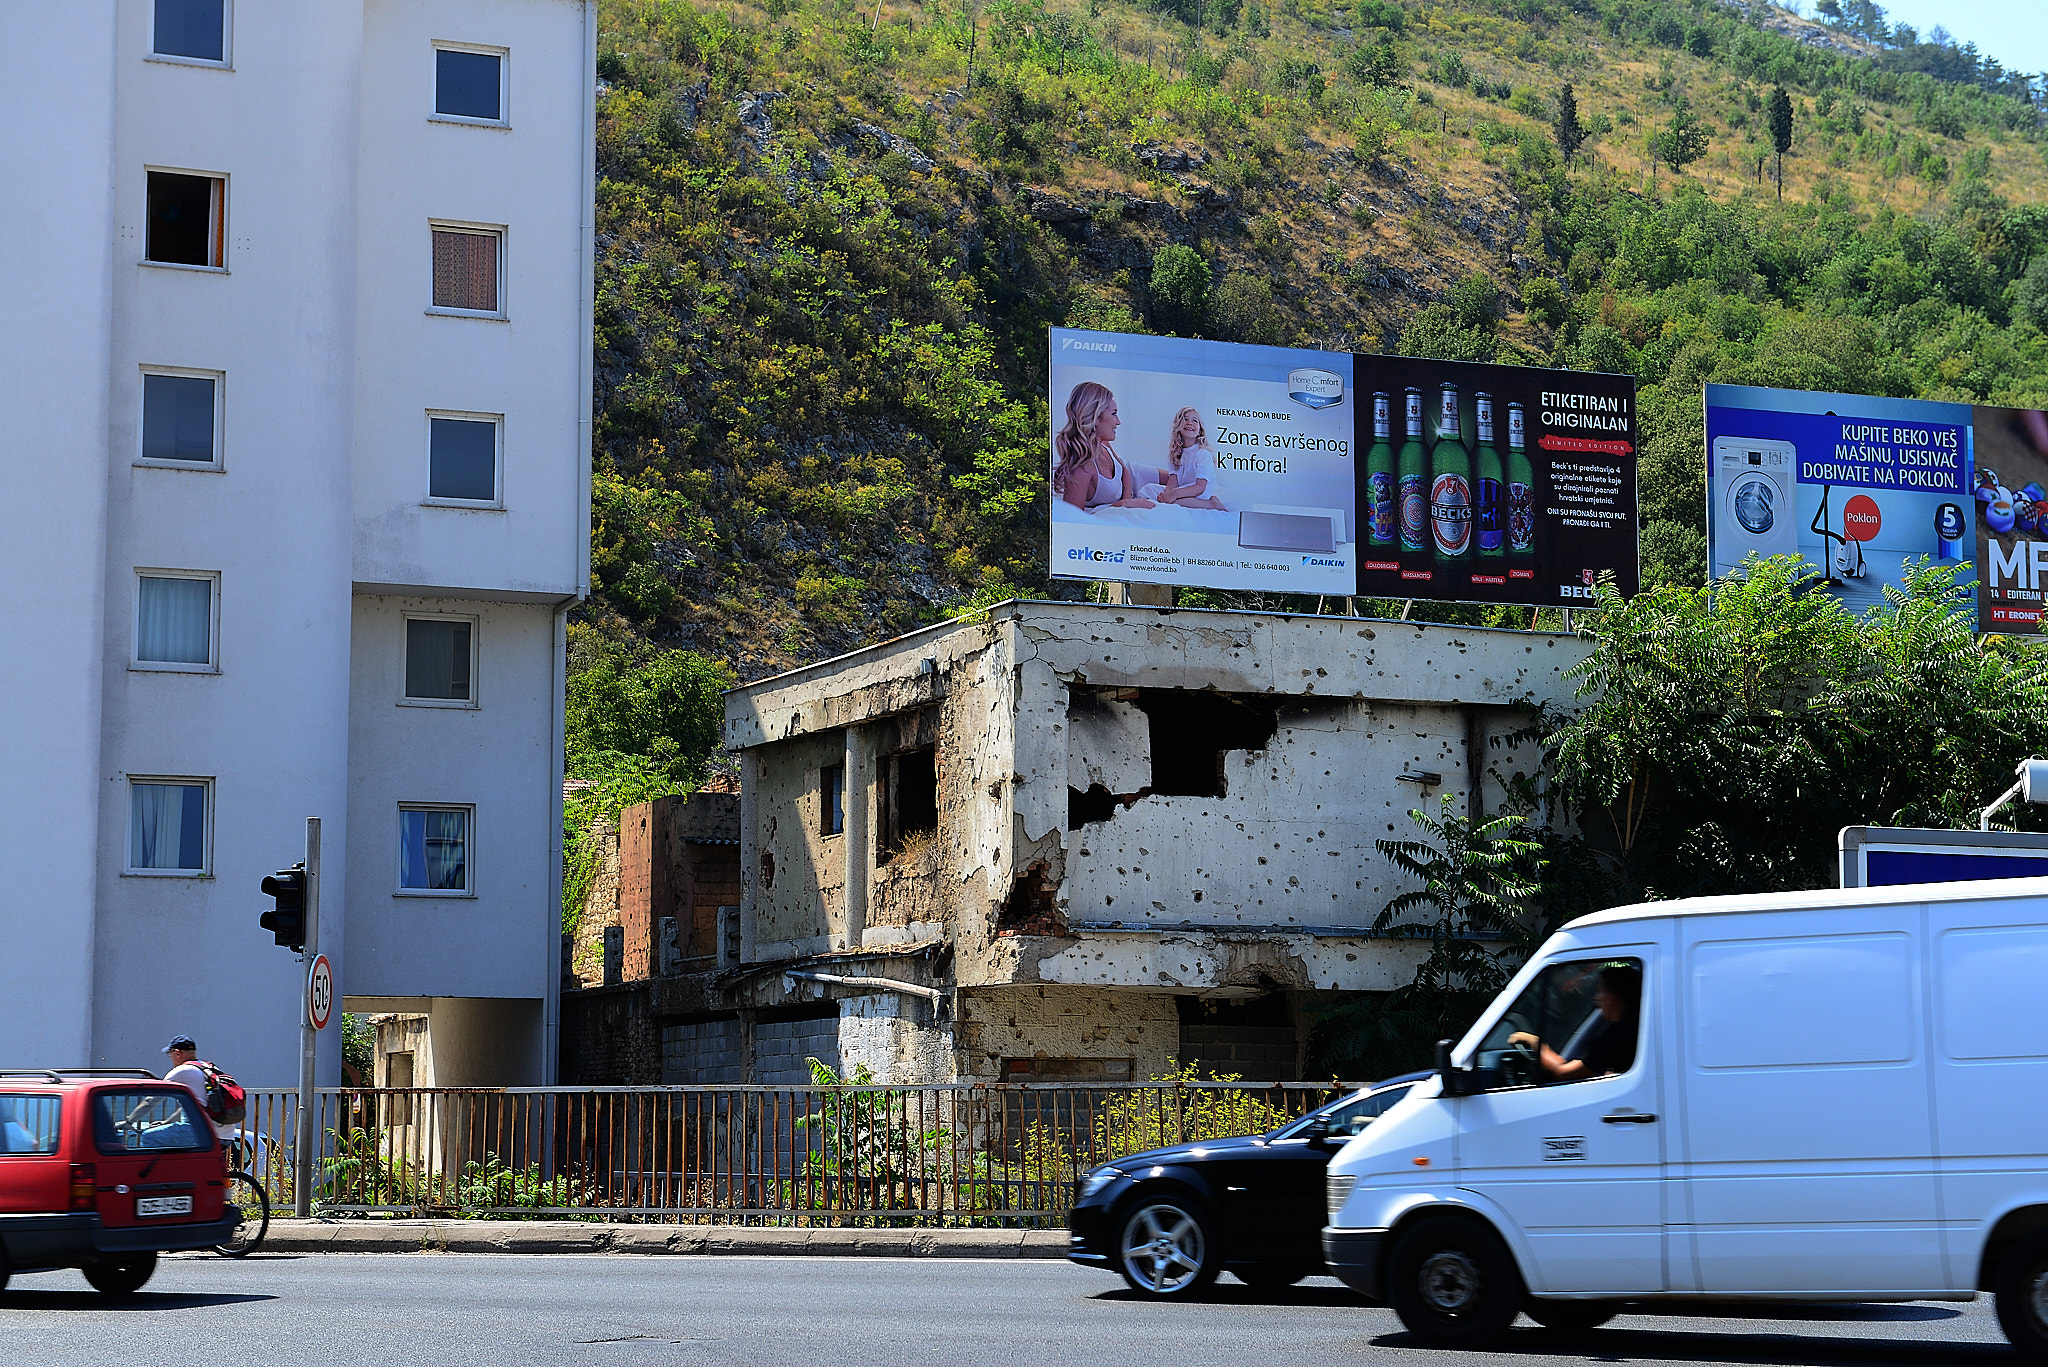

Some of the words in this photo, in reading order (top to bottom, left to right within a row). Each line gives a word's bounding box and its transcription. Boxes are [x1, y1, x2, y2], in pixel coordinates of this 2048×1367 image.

[1073, 341, 1117, 353] DAIKIN
[1292, 376, 1311, 384] Home
[1305, 384, 1326, 393] Expert
[1541, 392, 1618, 413] ETIKETIRAN
[1623, 398, 1627, 413] I
[1216, 408, 1236, 417] NEKA
[1237, 409, 1251, 418] VAŠ
[1252, 411, 1270, 419] DOM
[1271, 412, 1291, 421] BUDE
[1541, 411, 1628, 432] ORIGINALAN
[1216, 426, 1259, 446] Zona
[1264, 433, 1348, 457] savršenog
[1842, 424, 1889, 443] KUPITE
[1893, 428, 1929, 446] BEKO
[1933, 428, 1958, 448] VEŠ
[1547, 440, 1583, 448] LIMITED
[1588, 443, 1625, 451] EDITION
[1835, 442, 1895, 466] MAŠINU,
[1899, 448, 1958, 469] USISIVAČ
[1803, 462, 1870, 483] DOBIVATE
[1873, 467, 1895, 484] NA
[1899, 469, 1959, 489] POKLON.
[1558, 493, 1584, 502] hrvatski
[1431, 505, 1472, 520] BECK'S
[1846, 512, 1879, 524] Poklon
[1942, 506, 1956, 528] 5
[1130, 544, 1153, 553] Erkond
[1130, 554, 1149, 562] Blizne
[1149, 555, 1171, 563] Gomile
[1266, 563, 1278, 571] 640
[1311, 558, 1345, 567] DAIKIN
[1129, 564, 1178, 574] www.erkond.ba
[1990, 589, 1999, 599] 14
[1993, 610, 2006, 619] HT
[2008, 611, 2041, 621] ERONET
[314, 975, 329, 1011] 50
